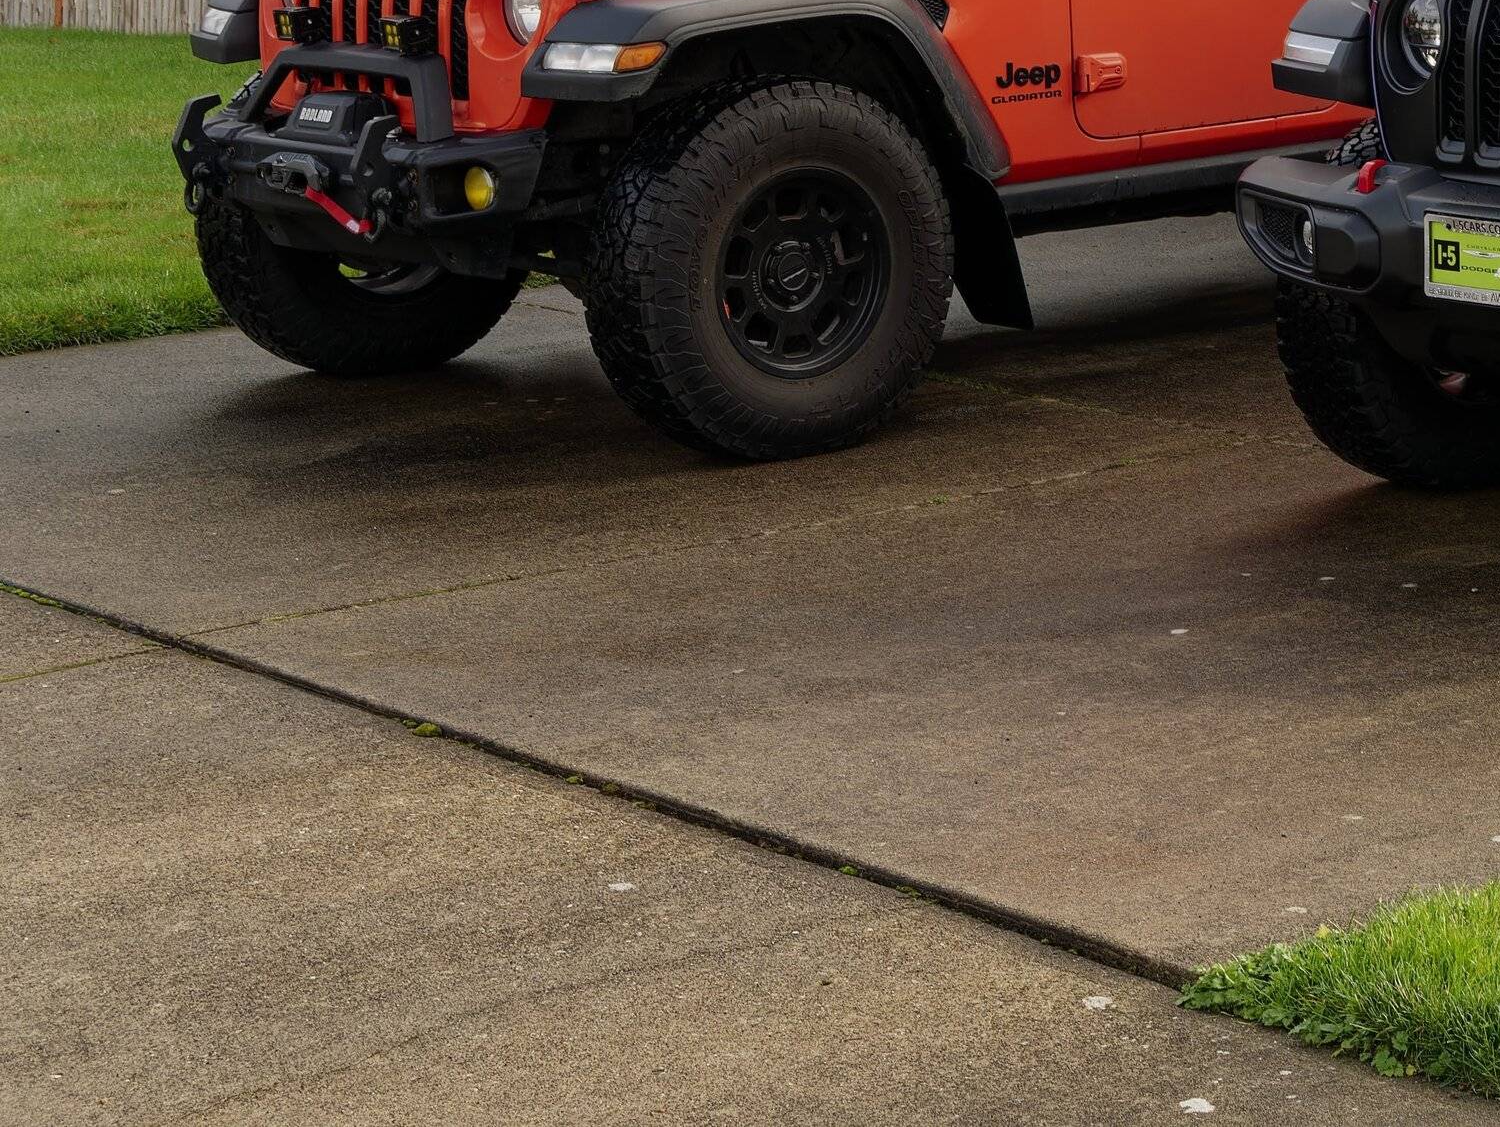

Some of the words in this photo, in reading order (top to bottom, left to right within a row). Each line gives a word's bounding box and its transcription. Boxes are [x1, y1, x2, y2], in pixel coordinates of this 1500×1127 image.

[995, 61, 1062, 89] Jeep
[991, 89, 1063, 105] GLADIATOR
[1436, 243, 1457, 267] I-5
[1461, 265, 1498, 274] DODGE
